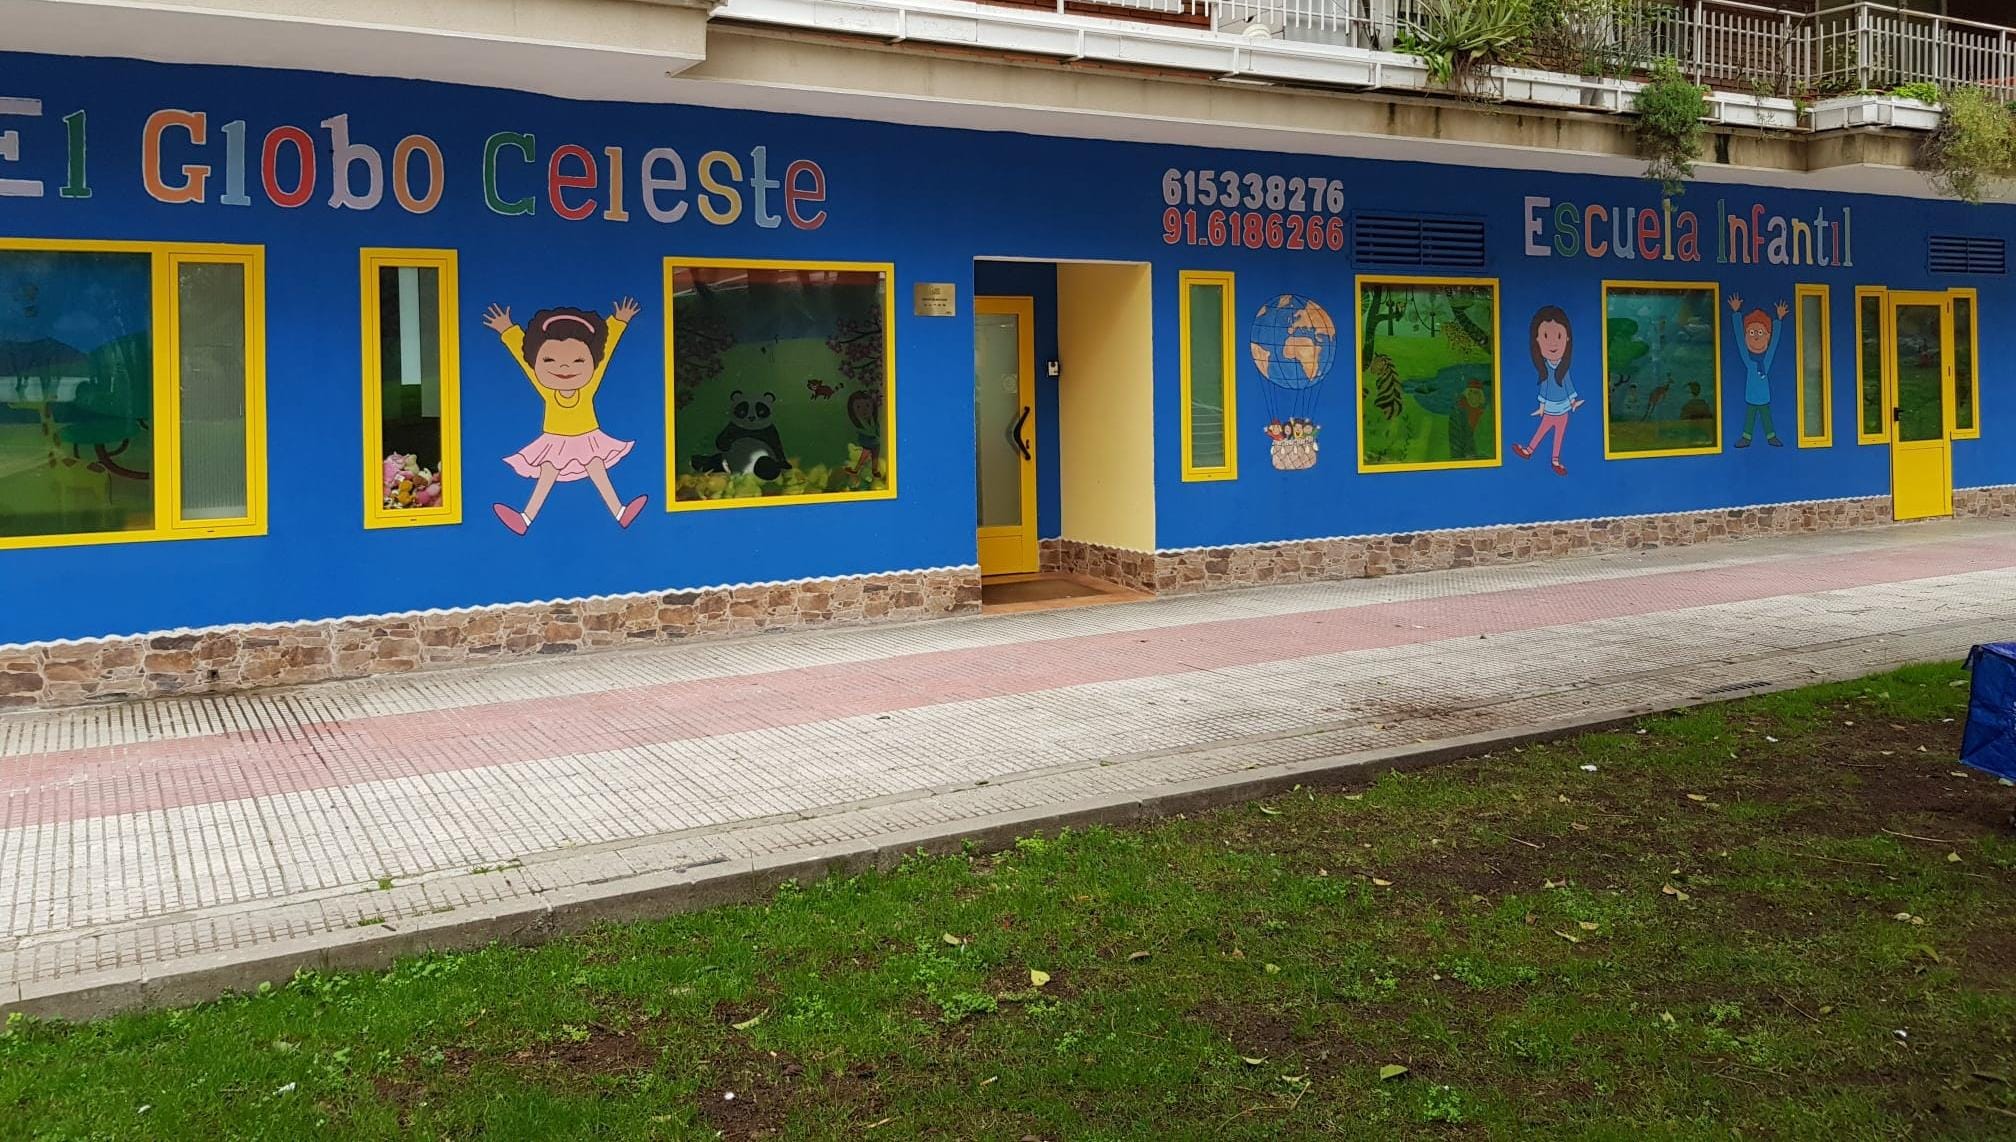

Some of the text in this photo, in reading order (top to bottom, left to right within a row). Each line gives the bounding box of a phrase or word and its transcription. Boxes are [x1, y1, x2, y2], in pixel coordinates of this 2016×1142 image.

[0, 96, 828, 230] El Globo Celeste
[1162, 168, 1345, 213] 615338276
[1162, 207, 1344, 251] 91.6186266
[1524, 195, 1853, 267] Escuela Infantil
